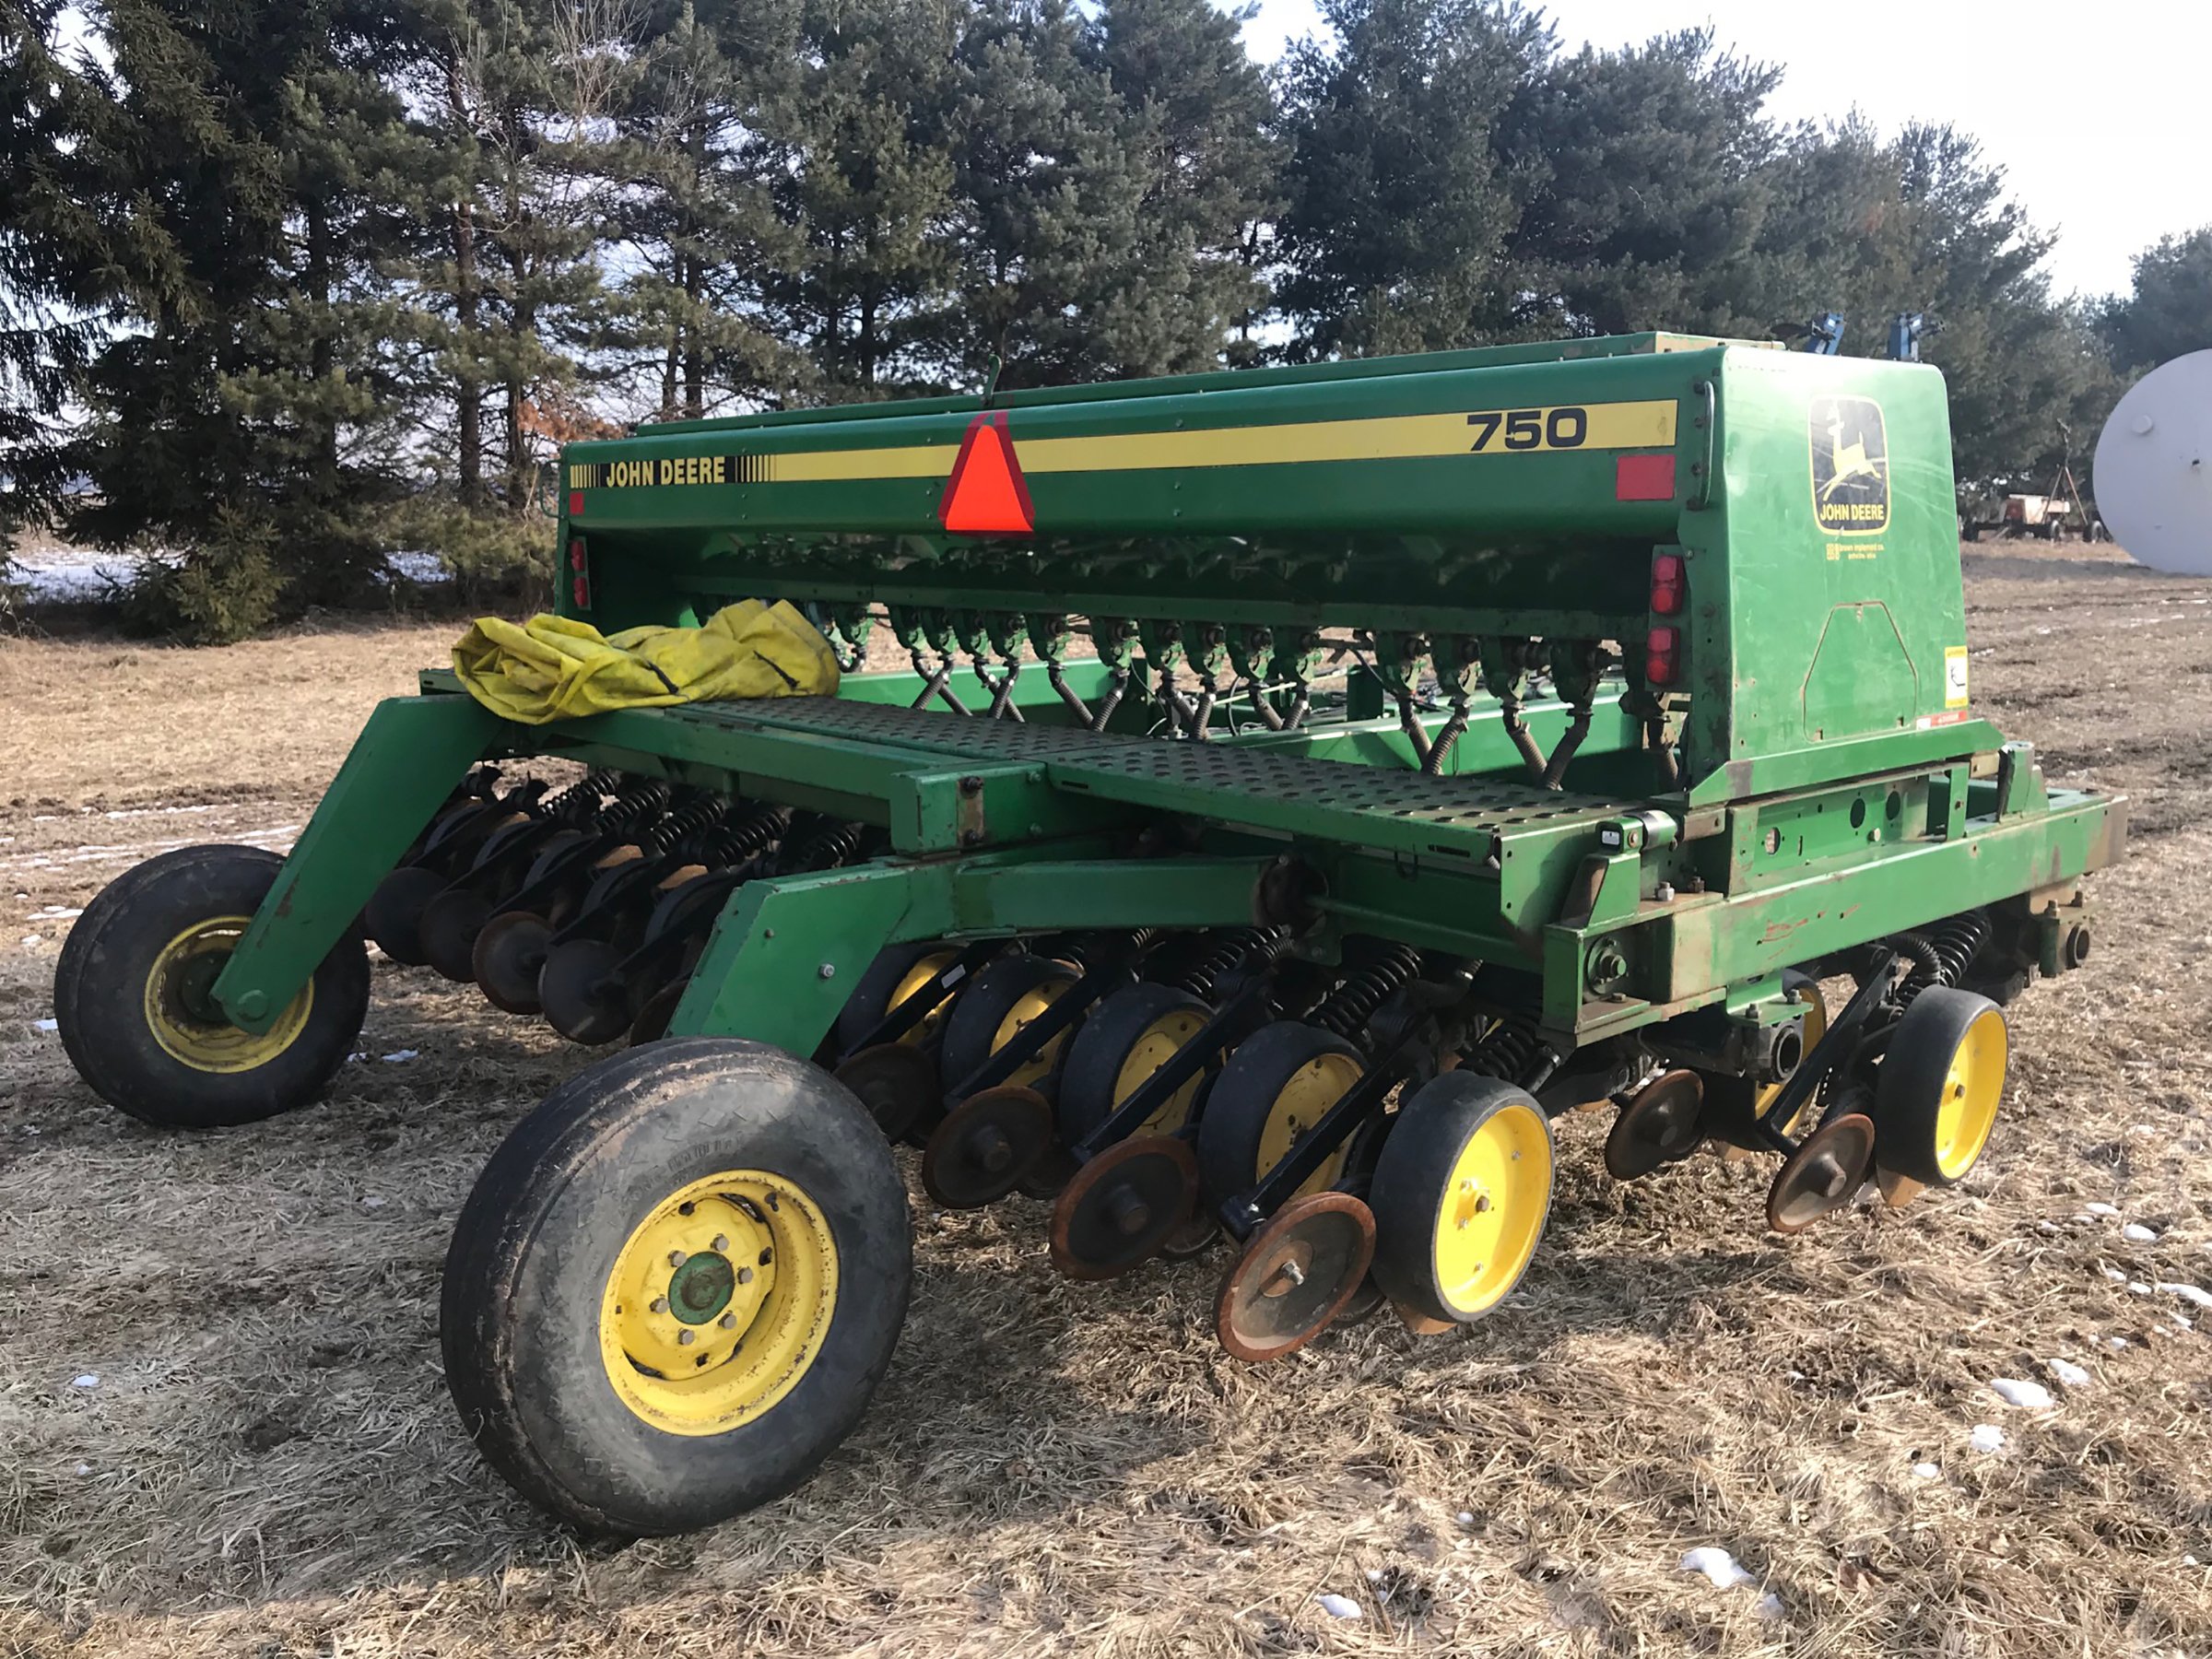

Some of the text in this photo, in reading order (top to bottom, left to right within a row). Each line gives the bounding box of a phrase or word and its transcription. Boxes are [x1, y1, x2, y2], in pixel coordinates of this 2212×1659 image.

[1466, 407, 1587, 452] 750
[606, 456, 725, 488] JOHN DEERE
[1820, 504, 1884, 521] JOHN DEERE
